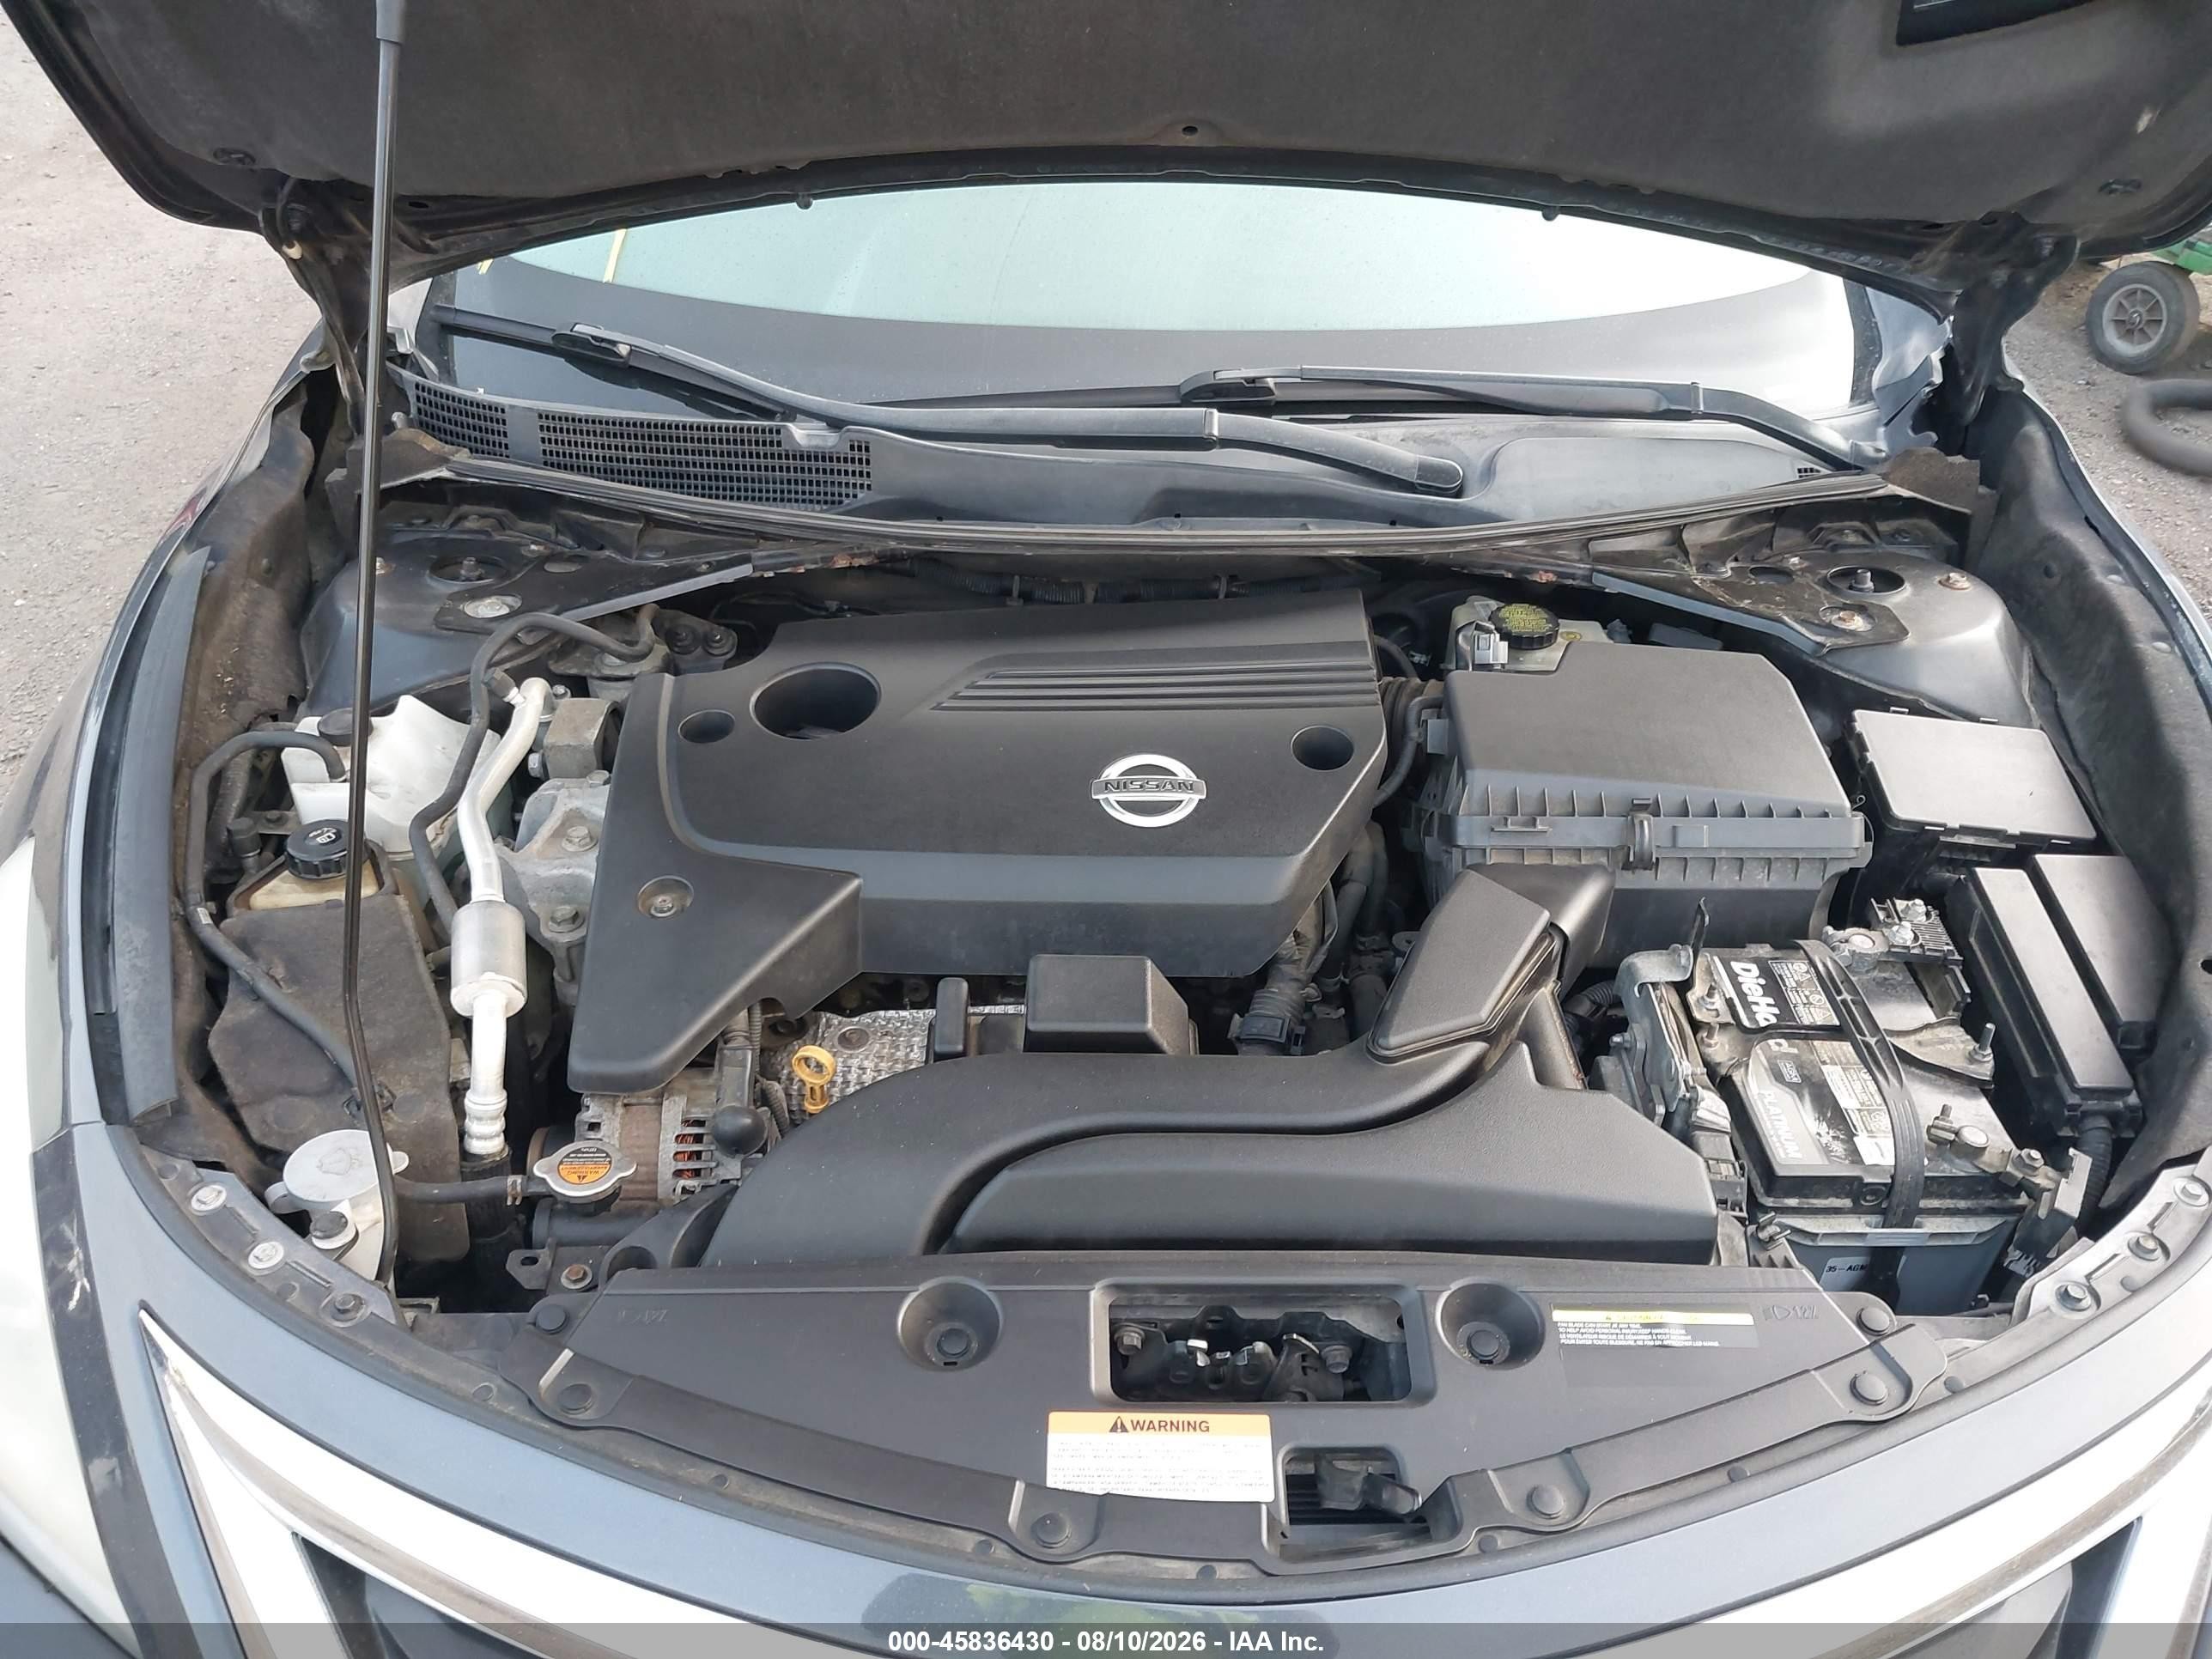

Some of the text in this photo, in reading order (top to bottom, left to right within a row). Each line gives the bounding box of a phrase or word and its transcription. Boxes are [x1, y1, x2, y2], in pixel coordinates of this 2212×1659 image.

[1104, 779, 1194, 793] NISSAN
[1761, 1088, 1803, 1159] PLATINUM
[1130, 1419, 1211, 1433] WARNING
